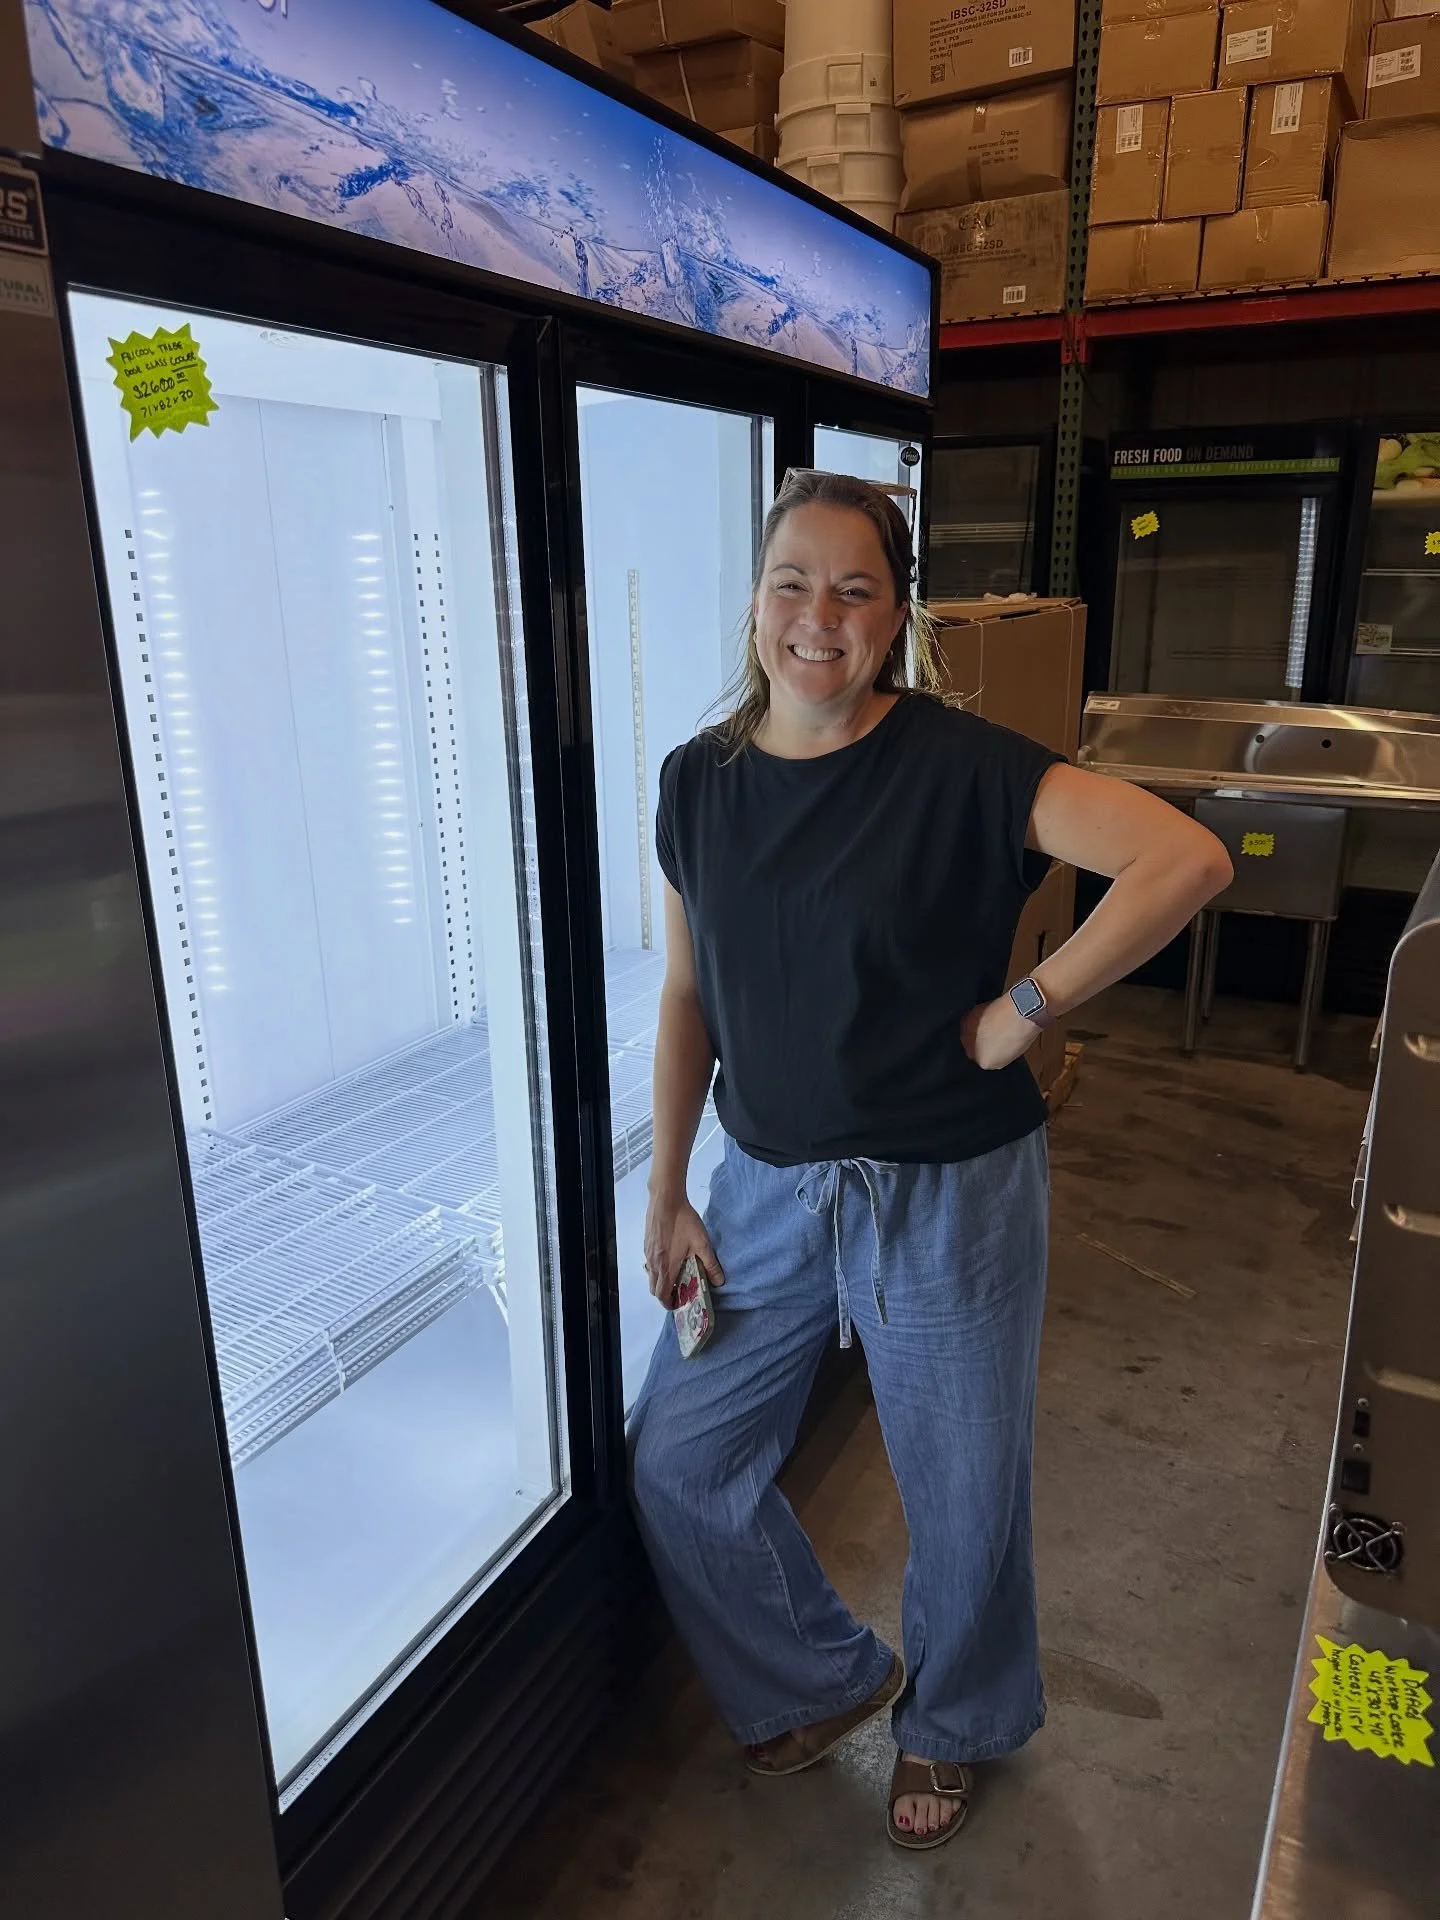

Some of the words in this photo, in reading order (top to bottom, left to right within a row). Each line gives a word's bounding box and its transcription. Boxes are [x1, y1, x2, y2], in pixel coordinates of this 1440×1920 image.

[950, 0, 1008, 21] IBSC-32SD
[145, 358, 168, 370] GLASS
[1114, 448, 1150, 466] FRESH
[1152, 447, 1182, 464] FOOD
[1205, 444, 1255, 461] DEMAND
